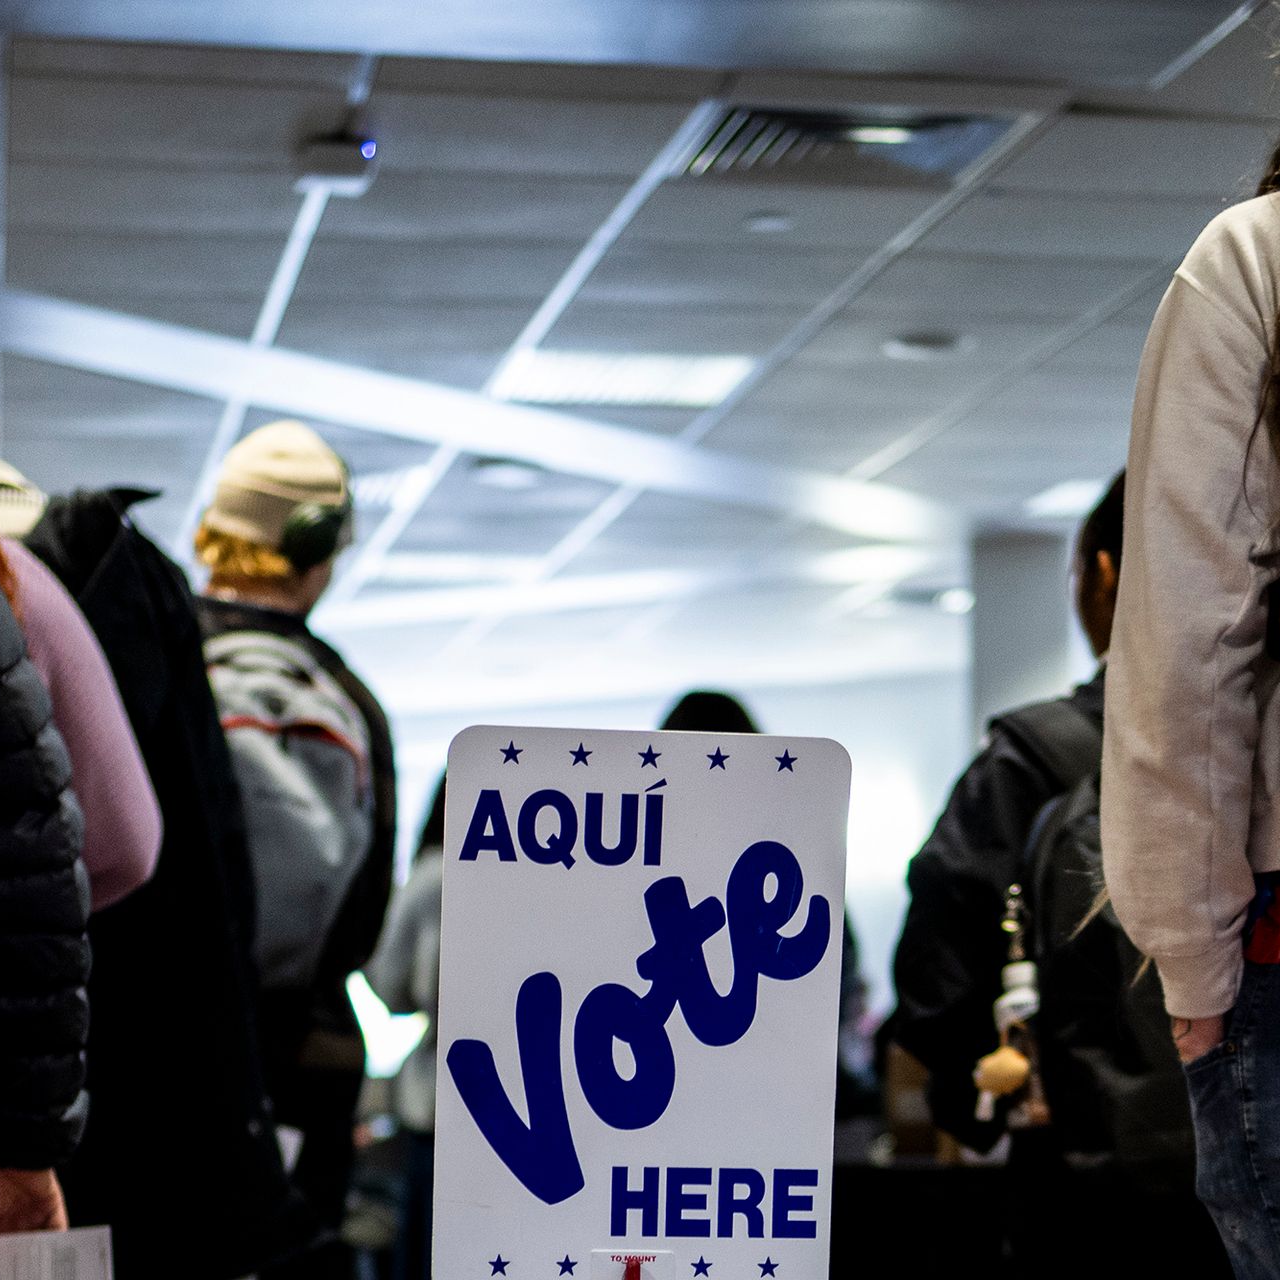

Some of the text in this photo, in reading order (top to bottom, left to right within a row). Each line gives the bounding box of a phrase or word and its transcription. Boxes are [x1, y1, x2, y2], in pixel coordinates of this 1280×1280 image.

[459, 779, 667, 870] AQUÍ
[446, 840, 830, 1205] Vote
[611, 1167, 818, 1239] HERE
